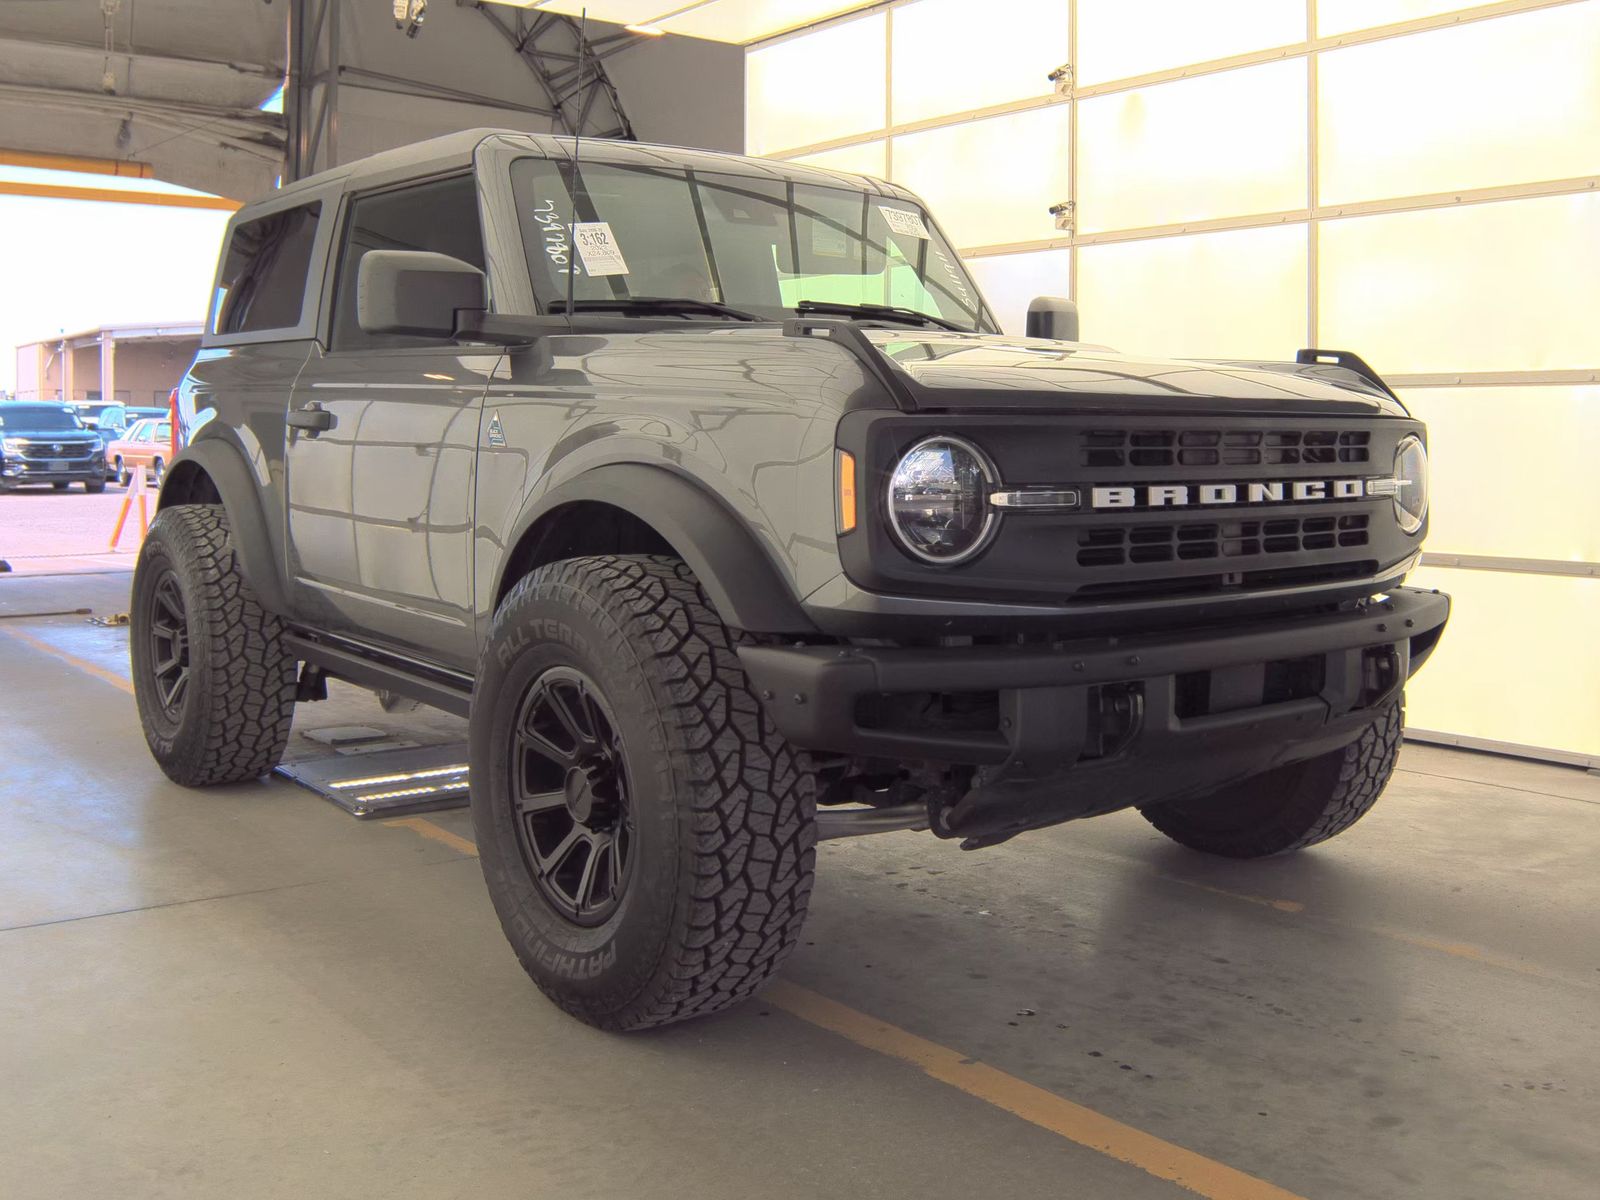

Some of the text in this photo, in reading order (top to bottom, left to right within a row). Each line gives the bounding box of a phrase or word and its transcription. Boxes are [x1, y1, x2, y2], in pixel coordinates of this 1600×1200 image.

[580, 232, 609, 246] 3:162
[1091, 480, 1364, 508] BRONCO
[497, 626, 530, 668] ALL
